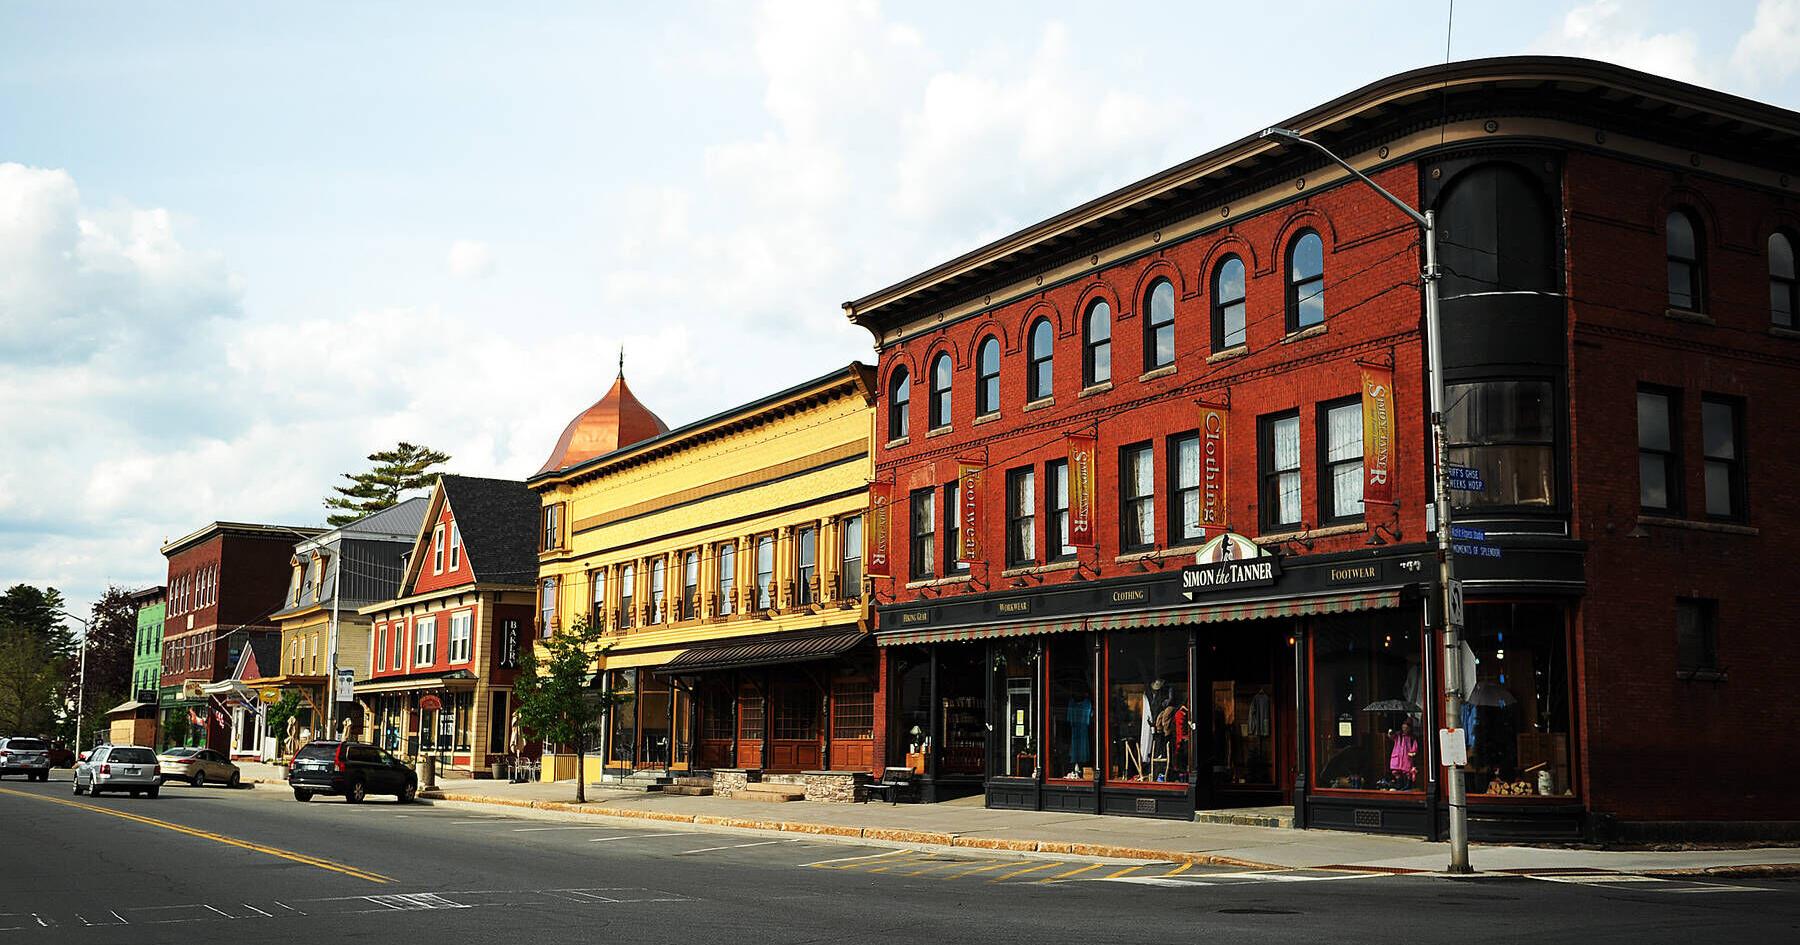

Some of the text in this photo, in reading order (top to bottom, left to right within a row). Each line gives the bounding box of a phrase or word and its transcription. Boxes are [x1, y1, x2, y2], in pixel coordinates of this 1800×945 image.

[1204, 411, 1220, 522] Clothing
[1183, 562, 1273, 588] SIMON the TANNER
[1331, 567, 1375, 581] FOOTWEAR
[1112, 590, 1144, 602] CLOTHING
[1000, 602, 1027, 612] WORKWEAR
